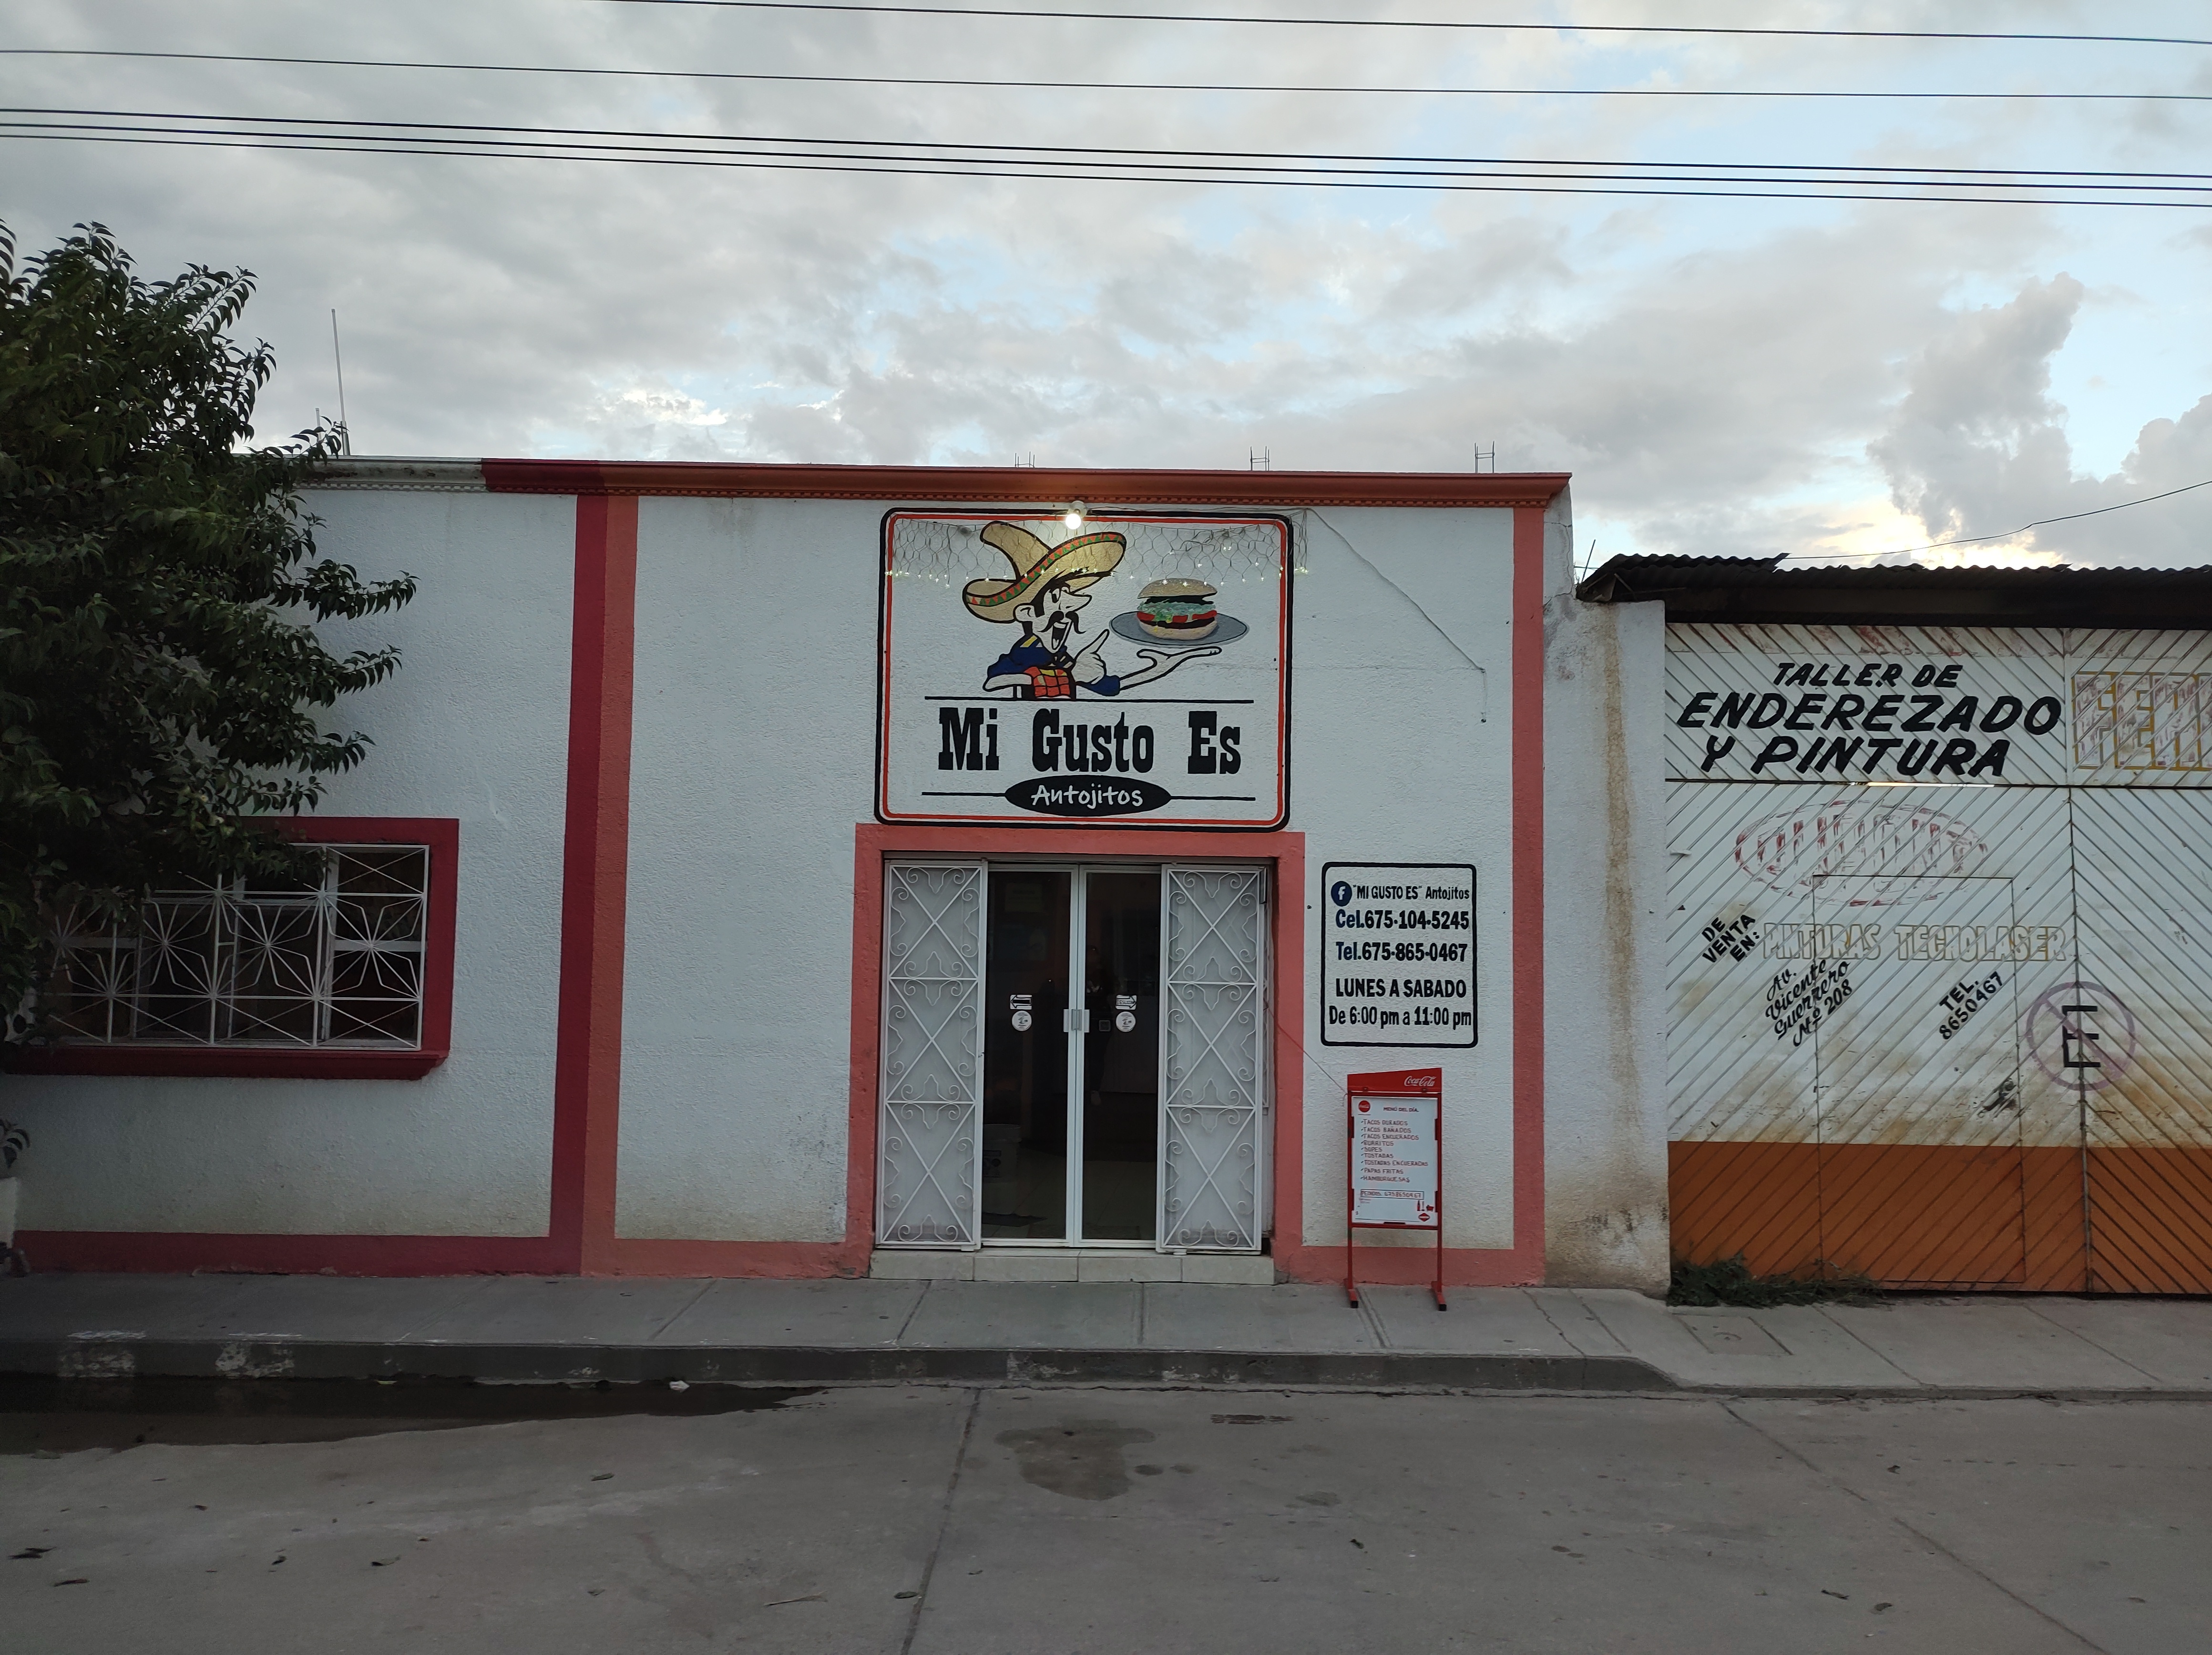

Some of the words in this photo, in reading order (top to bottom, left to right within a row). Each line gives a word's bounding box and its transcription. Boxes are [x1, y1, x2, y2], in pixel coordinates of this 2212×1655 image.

[1773, 663, 1903, 687] TALLER
[1911, 664, 1963, 688] DE
[1677, 692, 2061, 735] ENDEREZADO
[938, 707, 1000, 771] Mi
[1032, 708, 1154, 774] Gusto
[1187, 710, 1241, 775] Es
[1701, 735, 1736, 772] Y
[1751, 736, 2010, 777] PINTURA
[1031, 784, 1144, 810] Antojitos
[1371, 885, 1403, 900] GUSTO
[1425, 886, 1470, 900] Antojitos
[1701, 917, 1726, 942] DE
[1702, 914, 1756, 963] VENTA
[1729, 931, 1760, 962] EN:
[1763, 922, 1881, 960] PINTURAS
[1335, 978, 1386, 997] LUNES
[1389, 979, 1400, 997] A
[1403, 980, 1467, 998] SABADO
[1765, 960, 1826, 1021] Vicente
[1766, 968, 1797, 1001] Av.
[1774, 961, 1851, 1041] Guerrero
[1824, 979, 1852, 1015] 208
[1939, 981, 1979, 1011] TEL.
[1329, 1005, 1346, 1025] De
[1350, 1006, 1378, 1025] 6:00
[1381, 1010, 1400, 1029] pm
[1402, 1011, 1411, 1026] a
[1414, 1006, 1449, 1026] 11:00
[1453, 1011, 1472, 1031] pm
[1939, 971, 2003, 1040] 8650467
[2061, 1005, 2101, 1068] E
